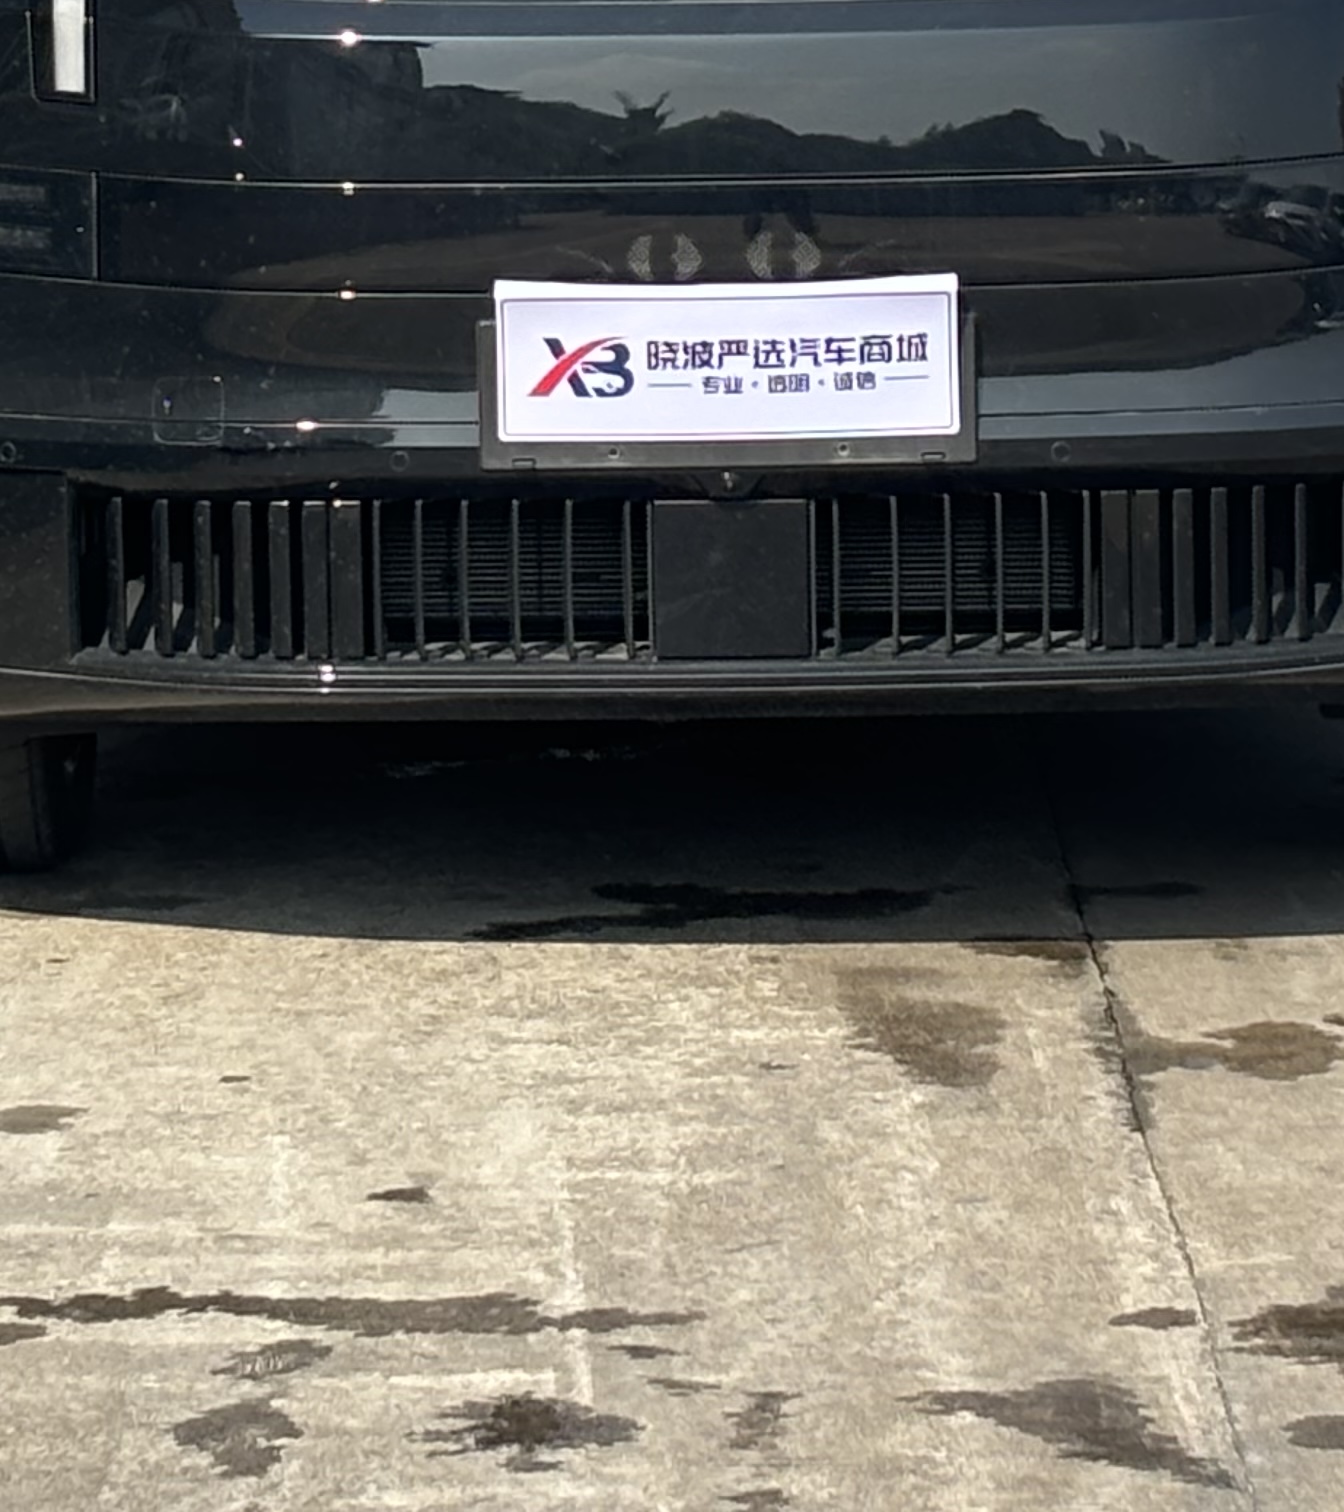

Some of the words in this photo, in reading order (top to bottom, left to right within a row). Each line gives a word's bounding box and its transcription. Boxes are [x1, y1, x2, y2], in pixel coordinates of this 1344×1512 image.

[645, 333, 929, 370] 晓波严选汽车商城
